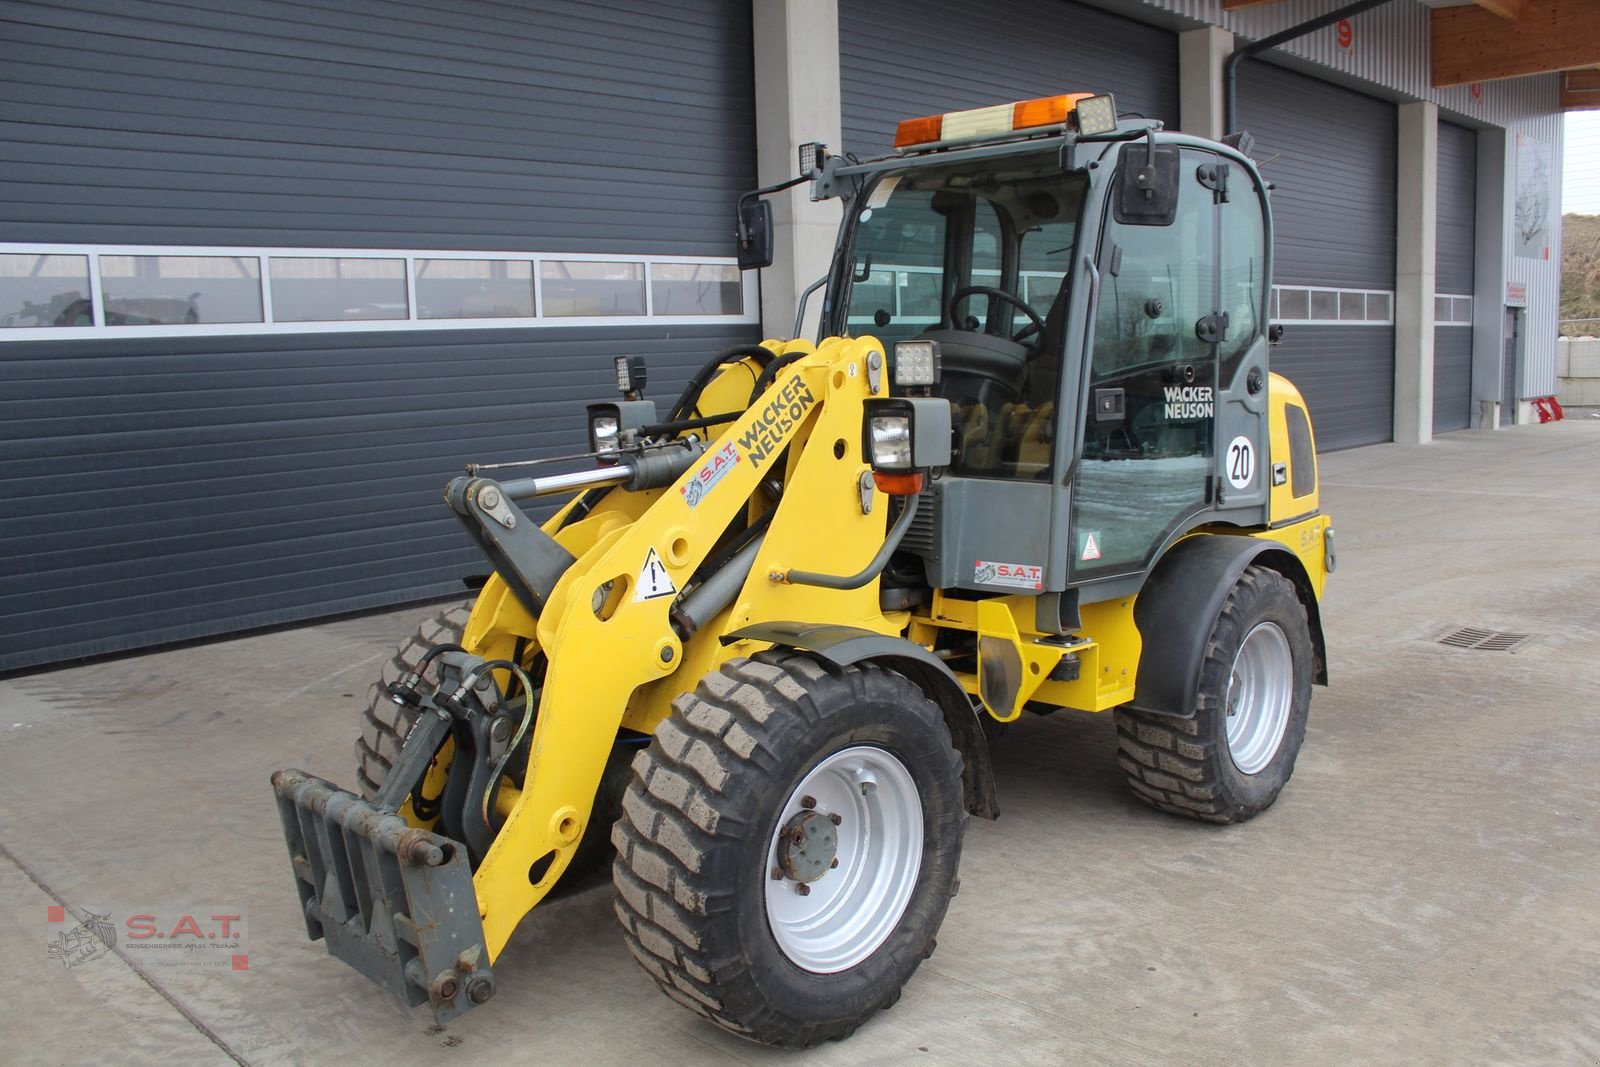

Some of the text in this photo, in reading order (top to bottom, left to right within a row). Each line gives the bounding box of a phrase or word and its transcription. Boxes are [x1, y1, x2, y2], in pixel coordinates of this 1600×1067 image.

[1337, 18, 1353, 48] 9
[1163, 386, 1214, 402] WACKER
[738, 374, 806, 450] WACKER
[1164, 403, 1214, 419] NEUSON
[748, 387, 815, 469] NEUSON
[700, 442, 736, 482] S.A.T.
[1231, 445, 1249, 480] 20
[997, 565, 1041, 579] S.A.T.
